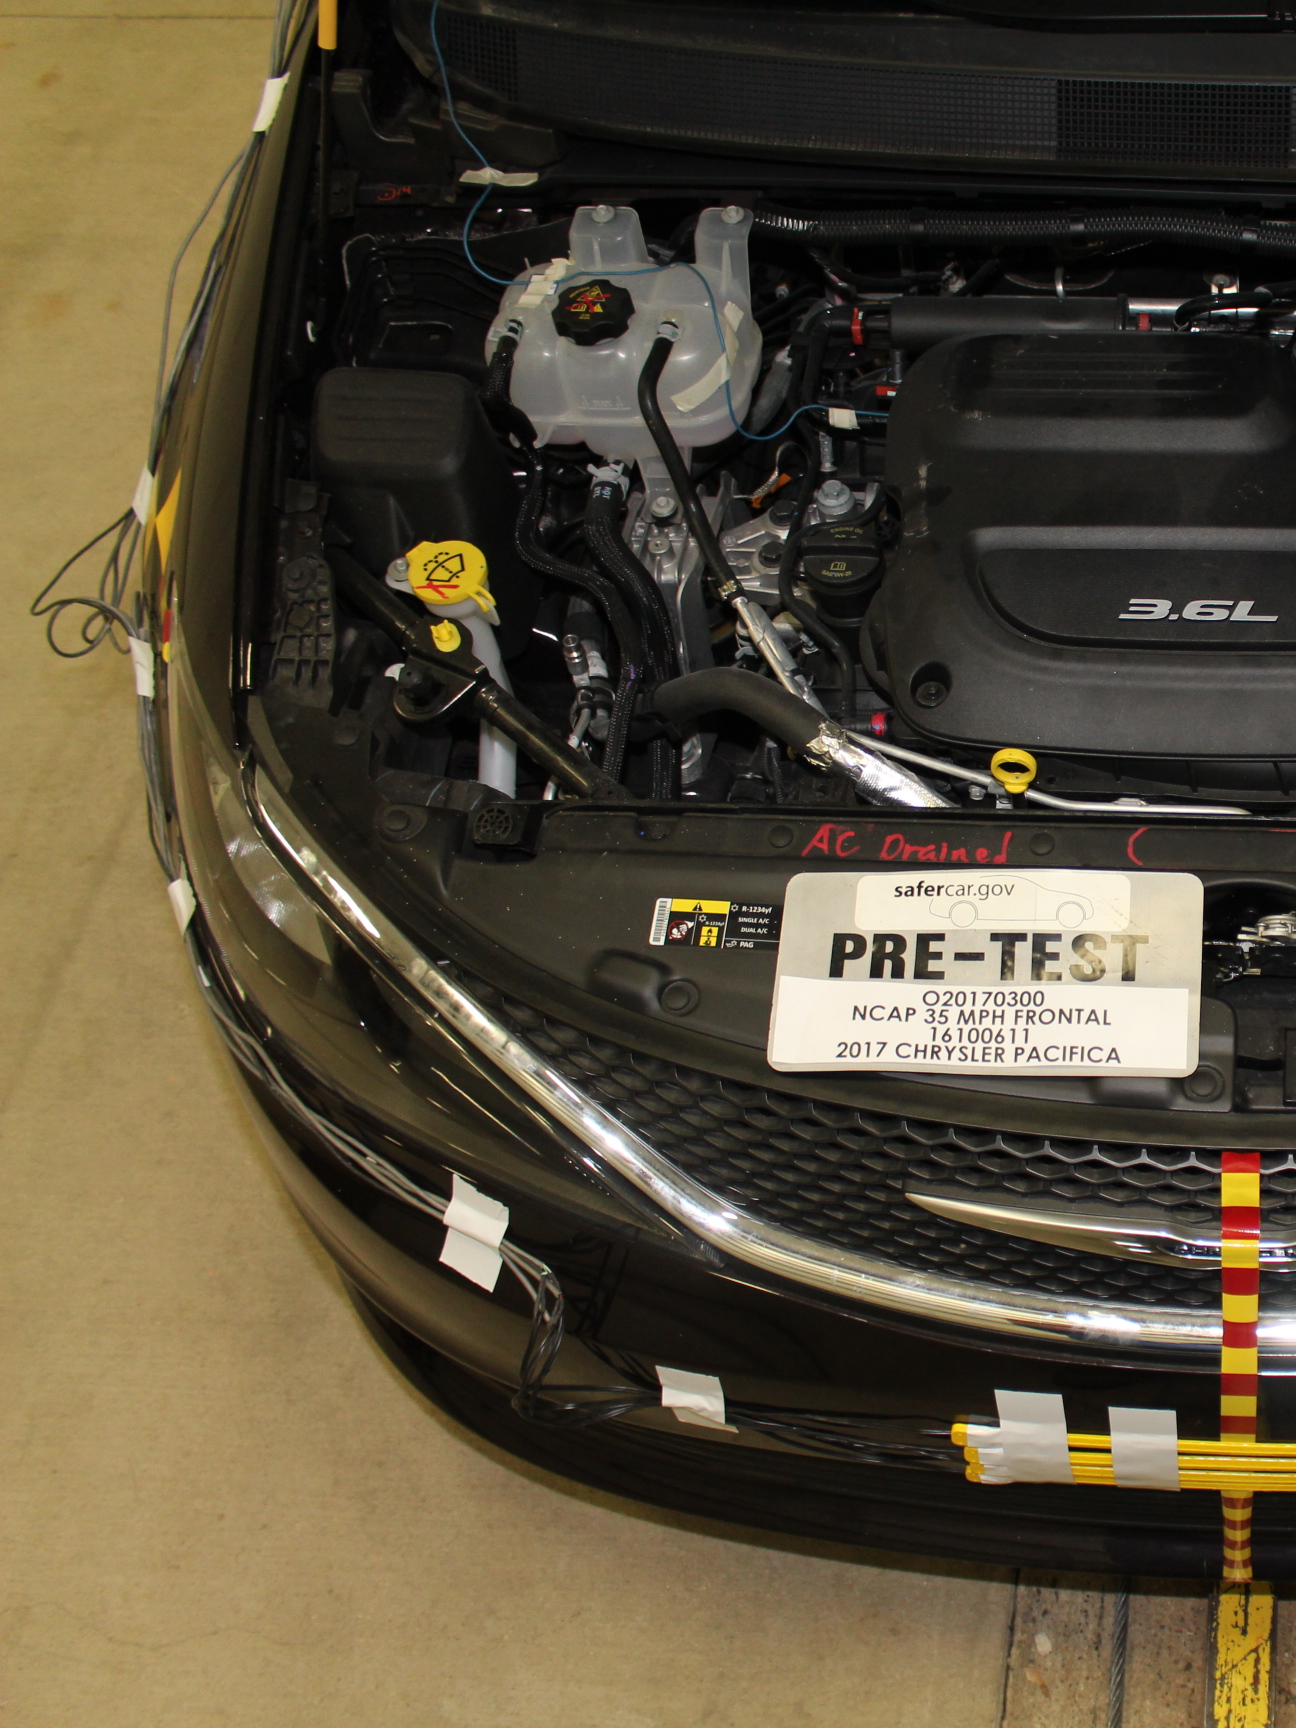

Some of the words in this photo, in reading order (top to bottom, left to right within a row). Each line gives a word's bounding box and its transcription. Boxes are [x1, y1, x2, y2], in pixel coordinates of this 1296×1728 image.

[1118, 598, 1279, 622] 3.6L
[801, 823, 860, 857] AC
[879, 831, 1012, 864] Drained
[894, 880, 1015, 901] safercar.gov
[742, 905, 772, 915] R-1234yf
[828, 932, 1150, 982] PRE-TEST
[852, 1005, 917, 1023] NCAP
[924, 1008, 949, 1025] 35
[957, 1009, 1005, 1026] MPH
[1014, 1008, 1112, 1026] FRONTAL
[930, 1026, 1030, 1044] 16100611
[835, 1041, 888, 1058] 2017
[895, 1042, 1005, 1063] CHRYSLER
[1014, 1045, 1122, 1064] PACIFICA
